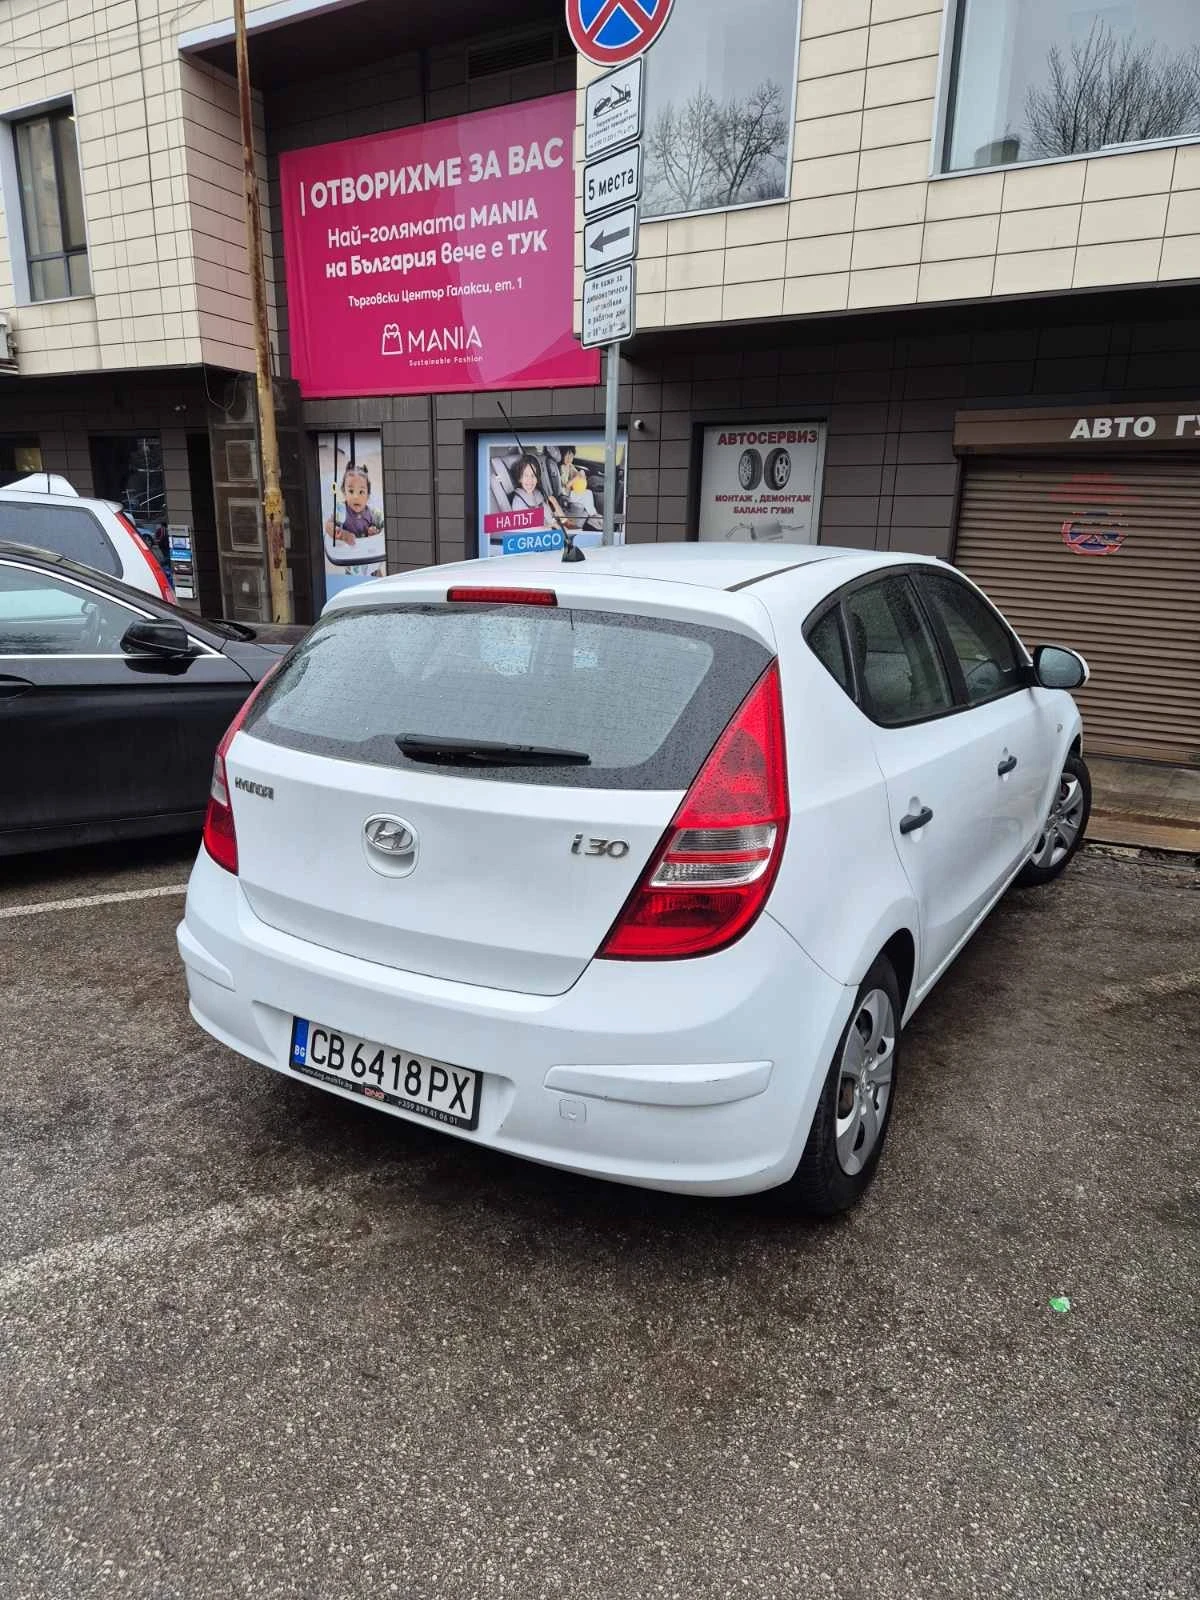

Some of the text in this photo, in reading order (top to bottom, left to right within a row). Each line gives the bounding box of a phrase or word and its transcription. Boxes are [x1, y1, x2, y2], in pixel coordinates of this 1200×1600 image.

[310, 137, 564, 209] ОТВОРИХМЕ ЗА ВАС
[588, 168, 634, 200] 5 места
[328, 198, 539, 249] Най-голямата MANIA
[326, 229, 548, 279] на България вече е ТУК
[348, 277, 523, 309] Търговски Център Галакси, ет. 1
[408, 325, 483, 353] MANIA
[409, 355, 483, 367] Sustainable Fashion
[717, 430, 818, 446] АВТОСЕРВИЗ
[1070, 416, 1156, 439] АВТО
[715, 494, 753, 502] МОНТАЖ
[760, 494, 811, 503] ДЕМОНТАЖ
[733, 506, 794, 514] БАЛАНС ГУМИ
[496, 512, 534, 528] НА ПЪТ
[517, 532, 561, 550] GRACO
[234, 776, 274, 800] HYUNDAI
[571, 833, 630, 858] i30
[294, 1044, 306, 1058] BG
[311, 1029, 470, 1114] CB 6418 PX
